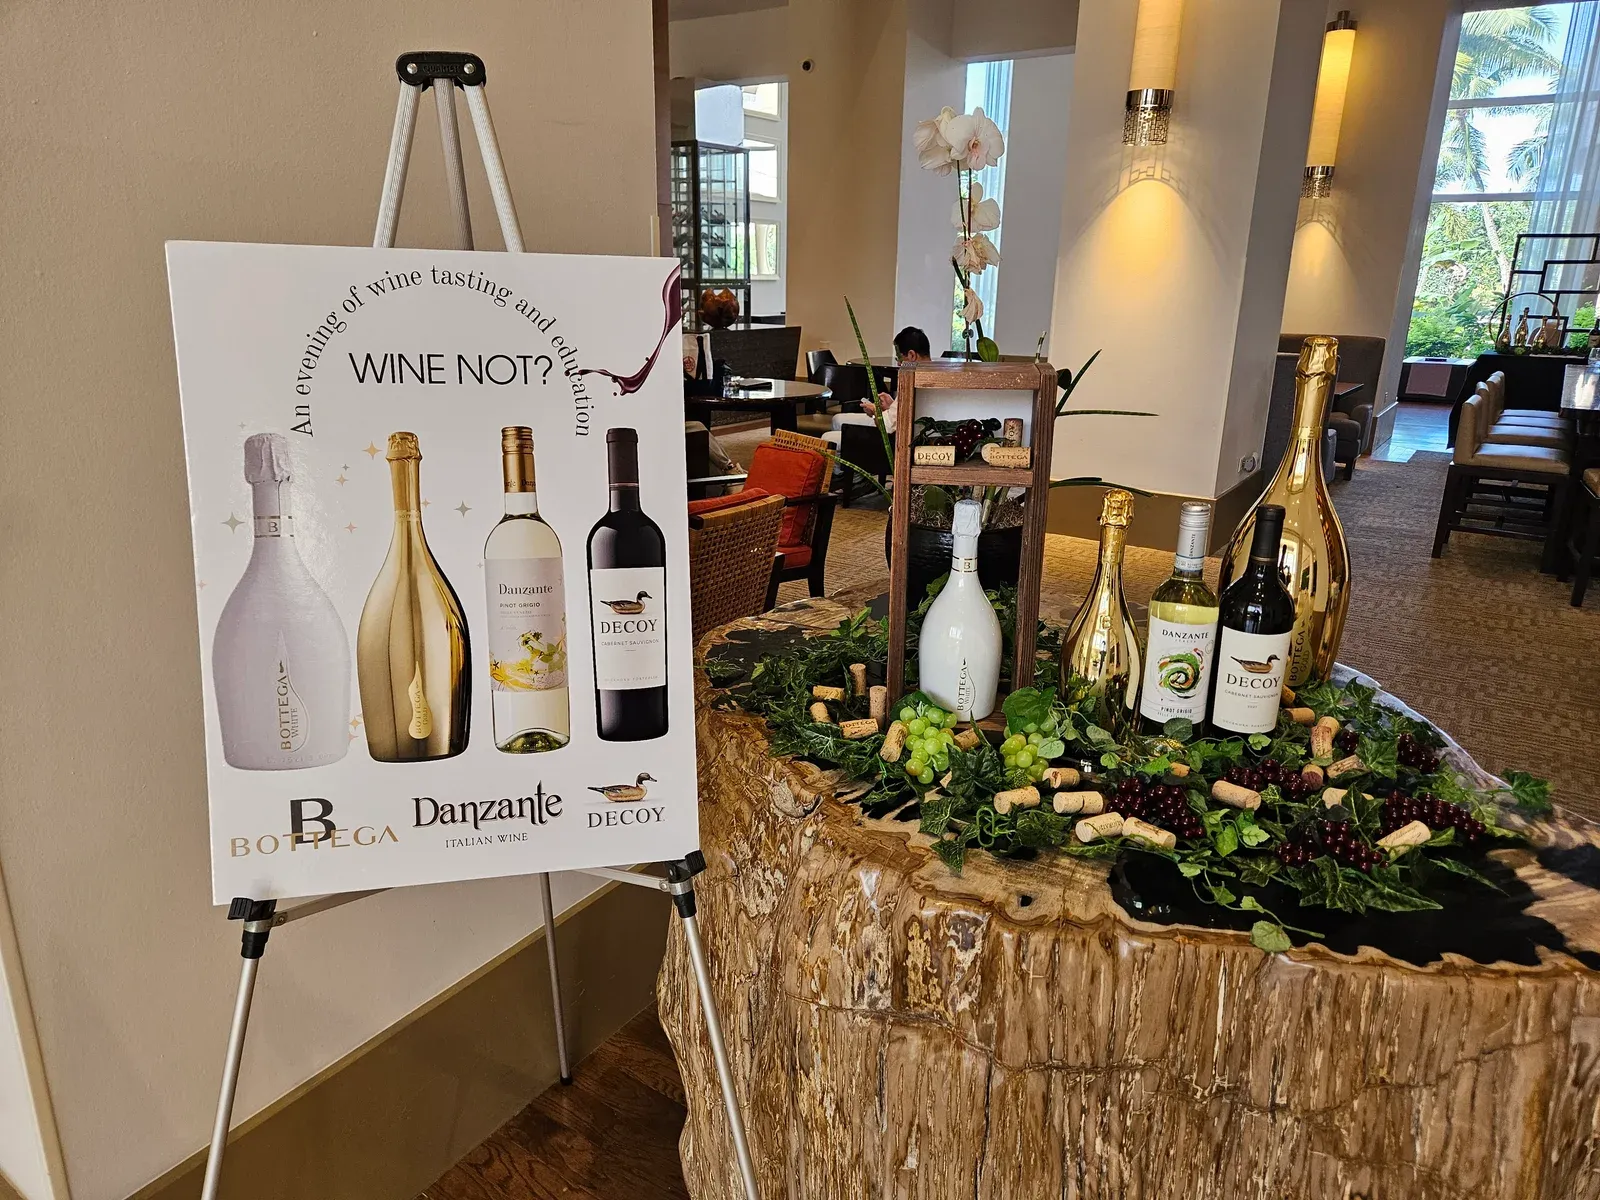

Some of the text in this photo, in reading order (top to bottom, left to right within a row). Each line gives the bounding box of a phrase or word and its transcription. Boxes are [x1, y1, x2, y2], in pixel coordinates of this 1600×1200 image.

[290, 264, 595, 437] An evening of wine tasting and education
[348, 352, 553, 386] WINE NOT?
[917, 452, 953, 461] DECOY
[268, 521, 279, 533] B
[963, 561, 971, 570] B
[499, 583, 553, 596] Danzante
[601, 619, 658, 634] DECOY
[1162, 629, 1209, 640] DANZANTE
[629, 638, 660, 646] SAUVIGNON
[1289, 630, 1306, 681] BOTTEGA
[957, 666, 968, 711] BOTTEGA
[1226, 673, 1281, 689] DECOY
[1225, 689, 1252, 699] CABERNET
[277, 675, 291, 750] BOTTEGA
[414, 690, 422, 734] BOTTEGA
[291, 708, 299, 738] WHITE
[411, 779, 563, 831] Danzante
[587, 807, 666, 828] DECOY
[230, 825, 399, 858] BOTTEGA
[445, 832, 529, 848] ITALIAN WINE
